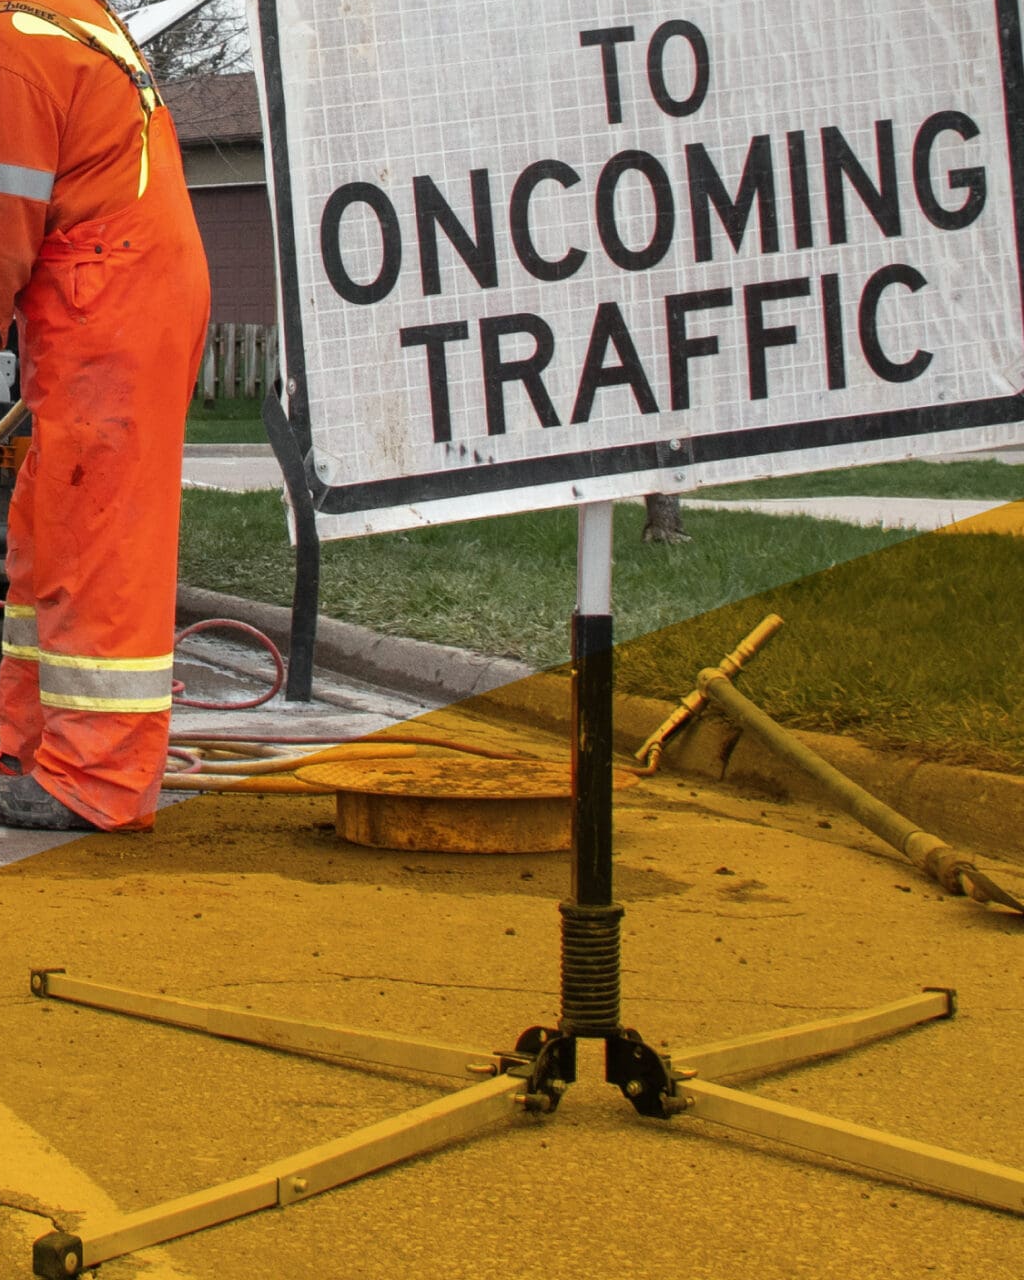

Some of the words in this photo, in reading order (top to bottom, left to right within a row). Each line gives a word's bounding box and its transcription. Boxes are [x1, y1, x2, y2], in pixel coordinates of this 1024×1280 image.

[580, 19, 709, 124] TO
[320, 111, 987, 305] ONCOMING
[400, 264, 933, 443] TRAFFIC
